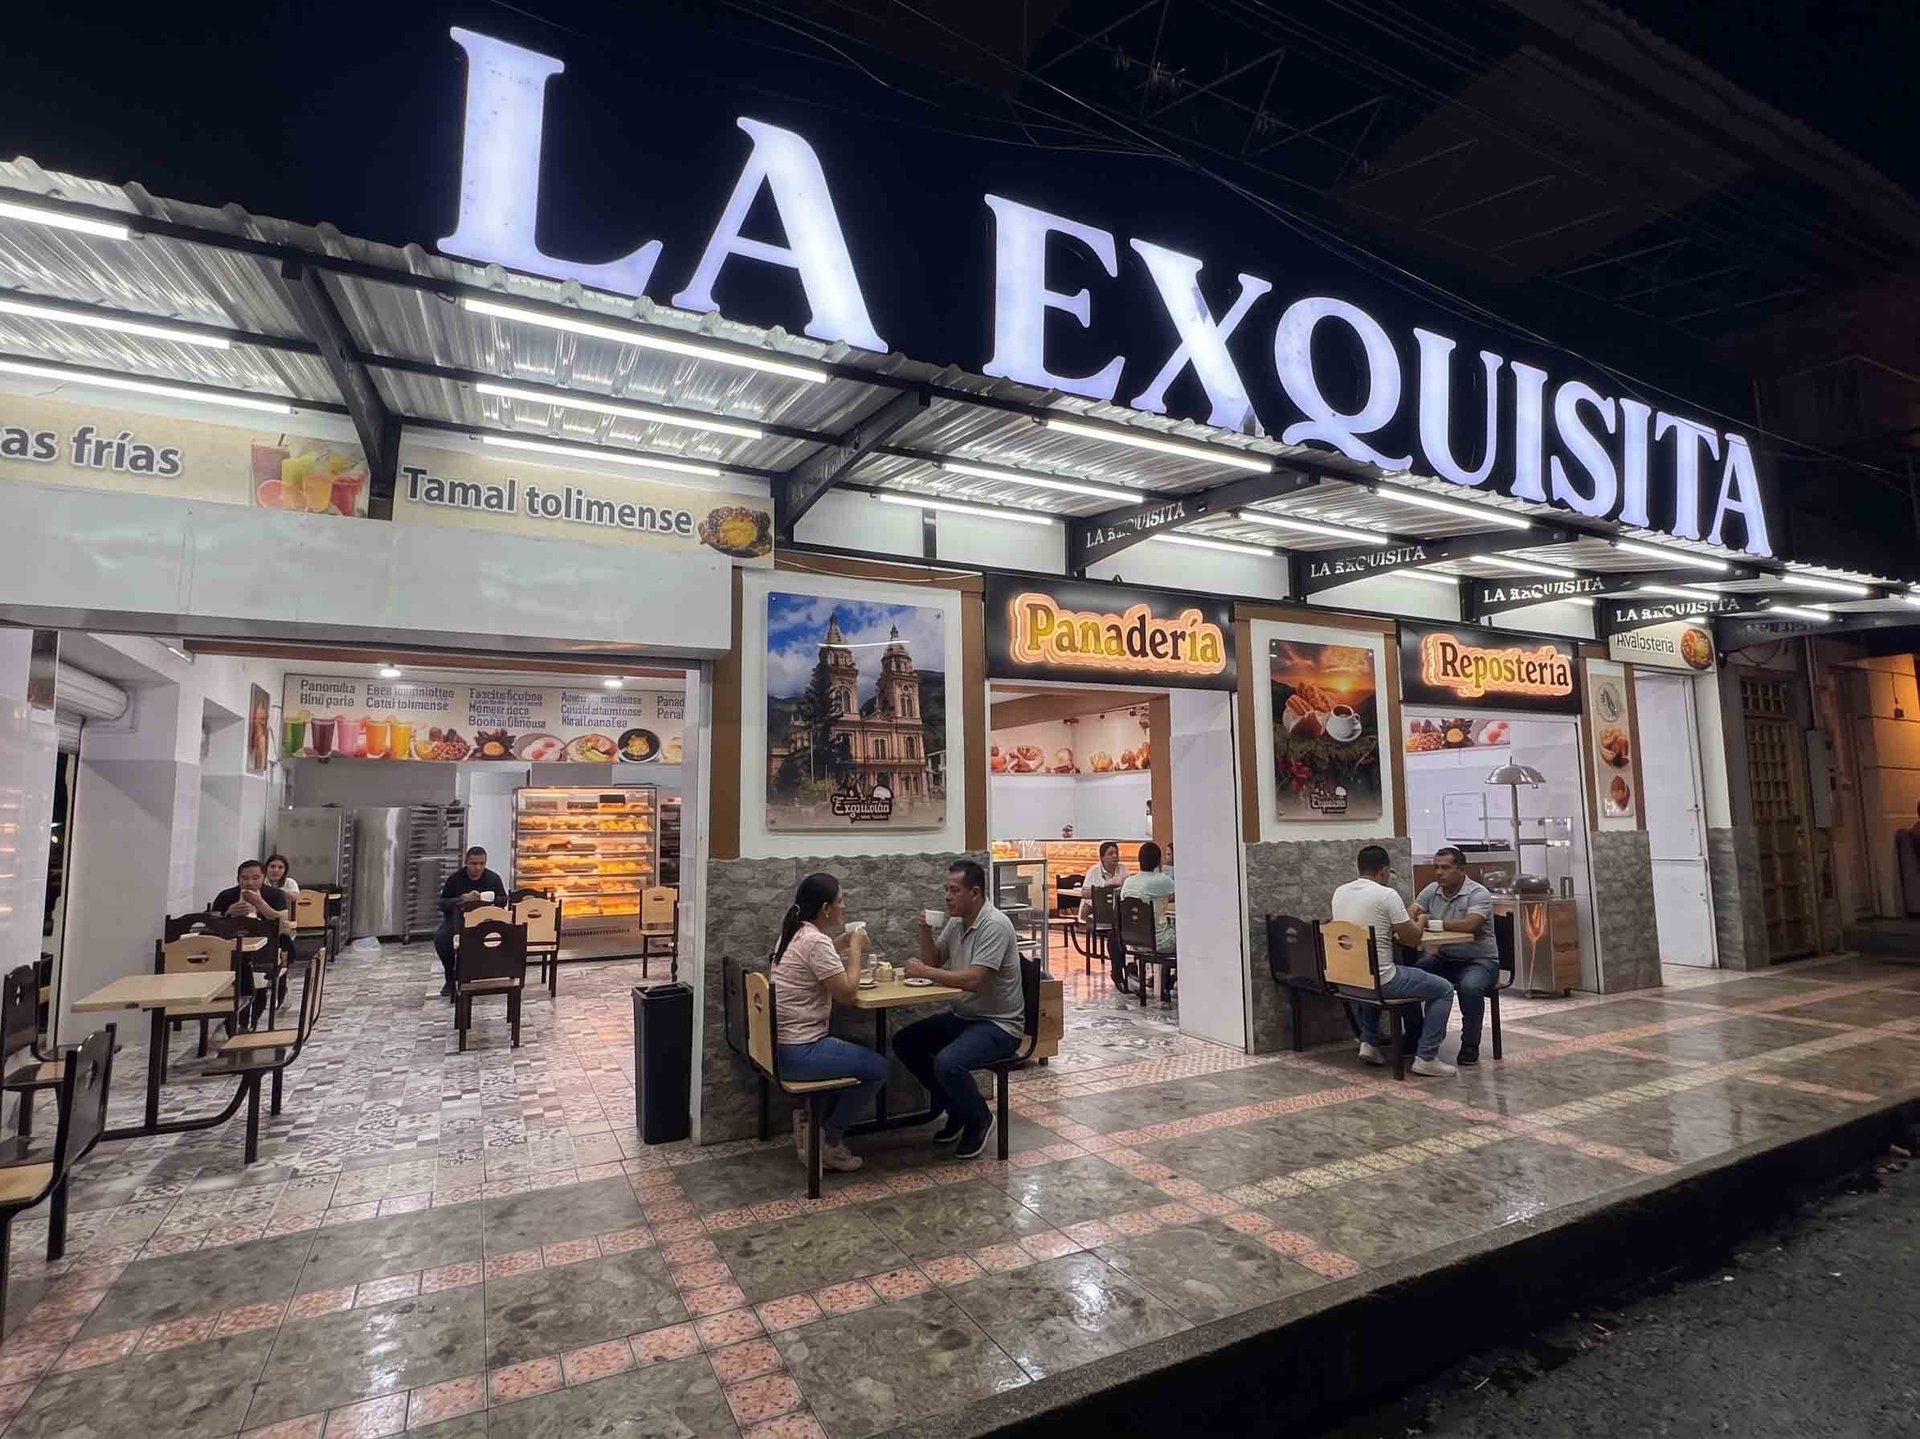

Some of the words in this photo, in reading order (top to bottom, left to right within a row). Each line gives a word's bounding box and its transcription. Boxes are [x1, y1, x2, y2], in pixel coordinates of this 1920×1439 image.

[437, 26, 888, 353] LA
[983, 194, 1774, 558] EXQUISITA
[72, 426, 181, 476] frías
[401, 465, 516, 512] Tamal
[525, 486, 694, 535] tolimense
[1310, 562, 1332, 578] LA
[1483, 588, 1506, 603] LA
[1616, 608, 1639, 622] LA
[1024, 601, 1223, 665] Panadería
[1438, 641, 1571, 690] Repostería
